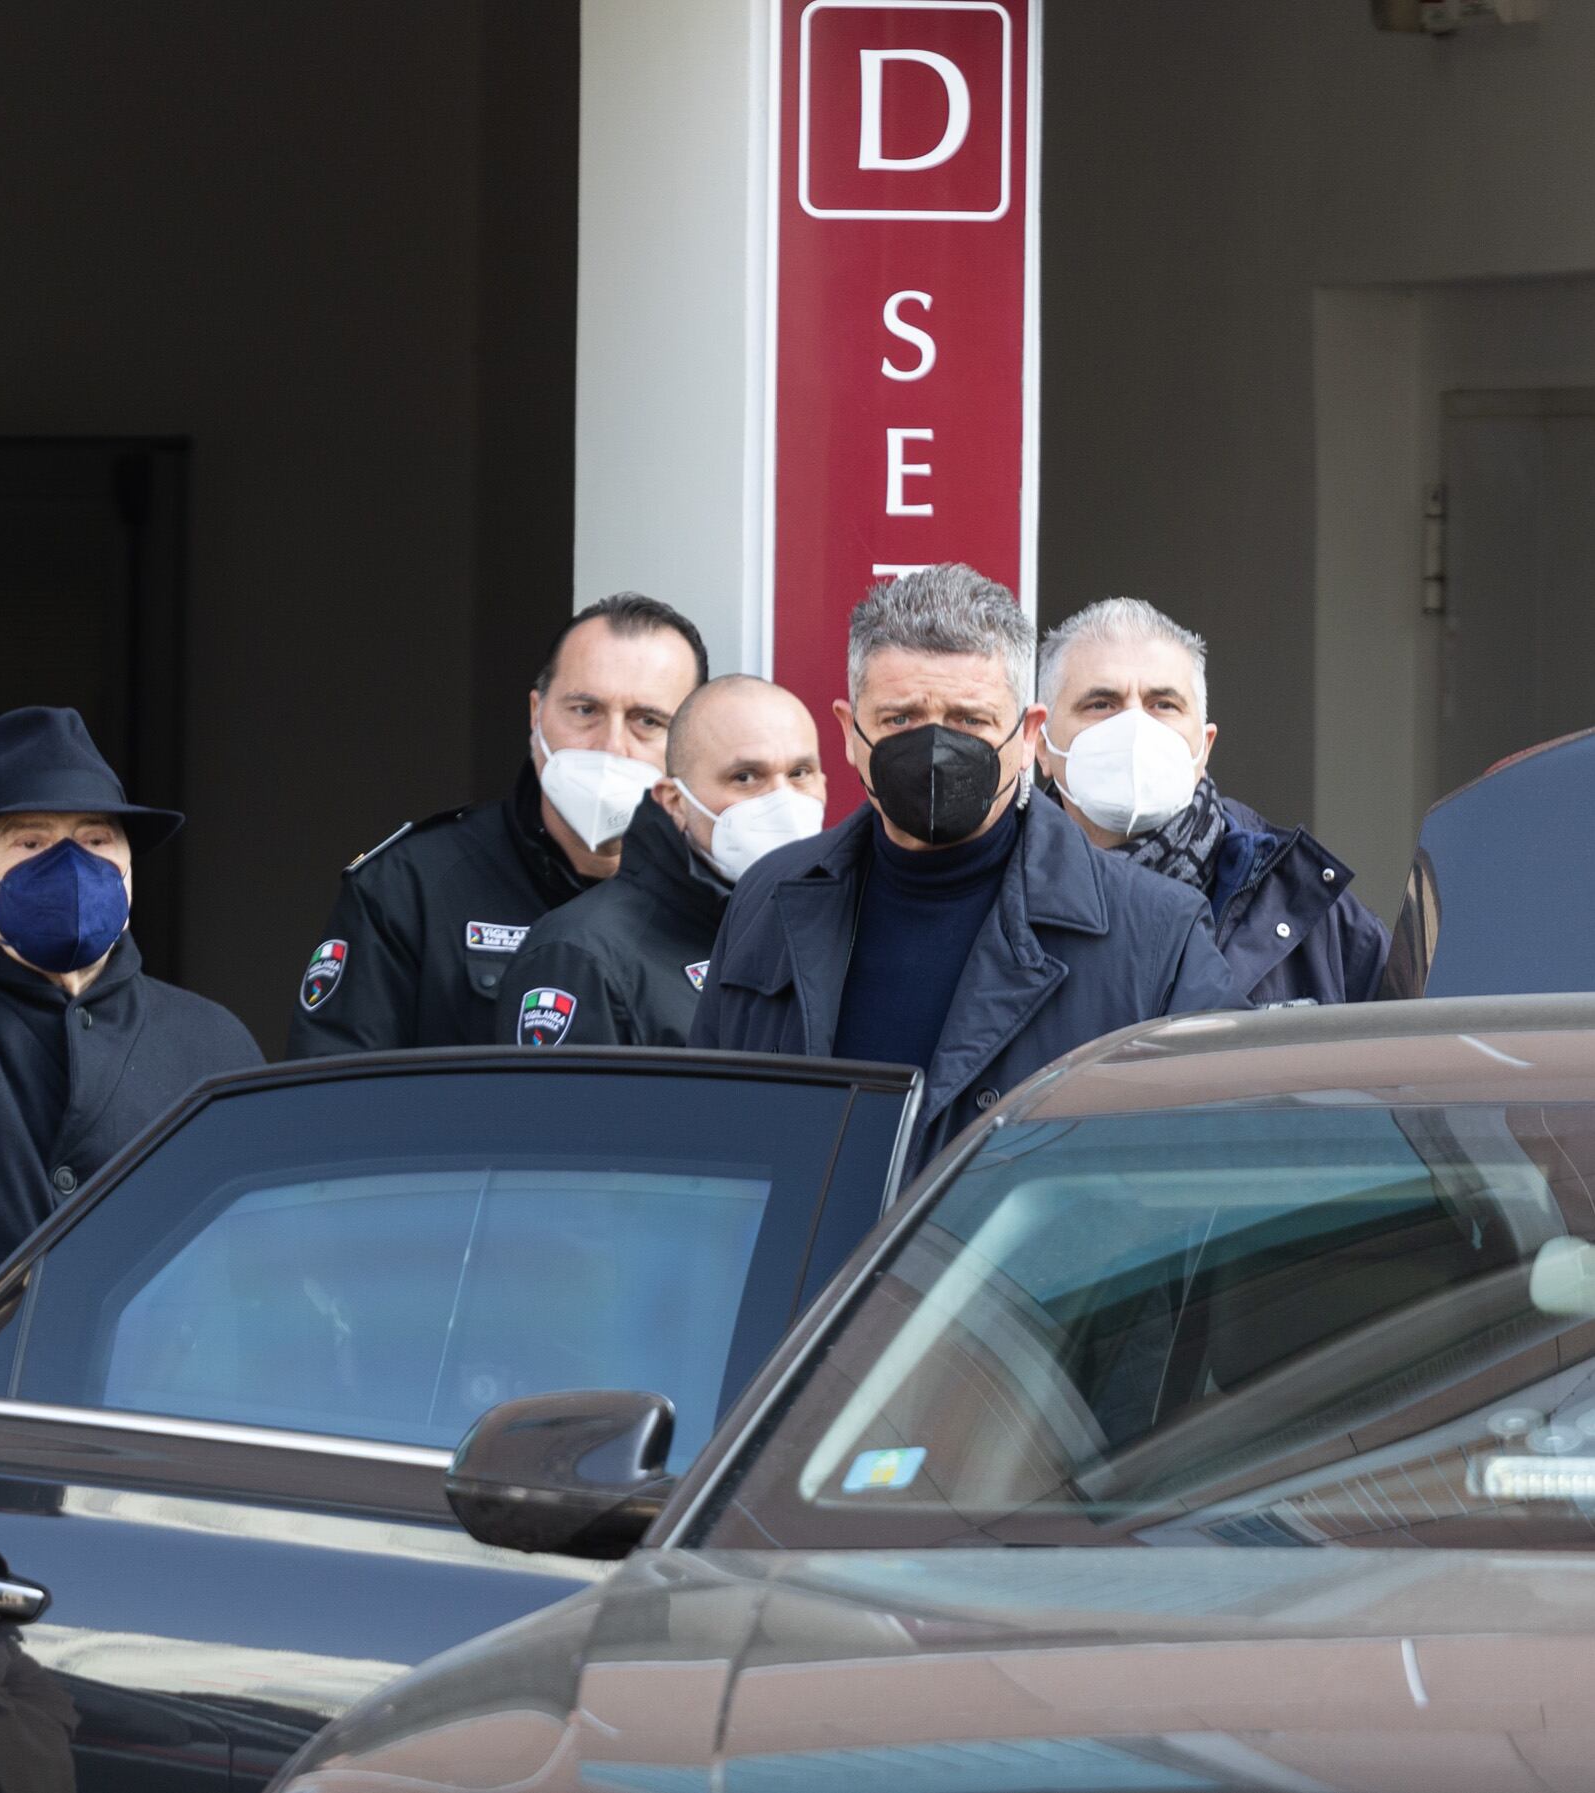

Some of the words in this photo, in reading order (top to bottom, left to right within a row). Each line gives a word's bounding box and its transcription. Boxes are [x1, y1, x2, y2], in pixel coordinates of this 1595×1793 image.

[858, 48, 971, 171] D
[872, 289, 937, 581] SE
[524, 1009, 566, 1026] VIGILANZA
